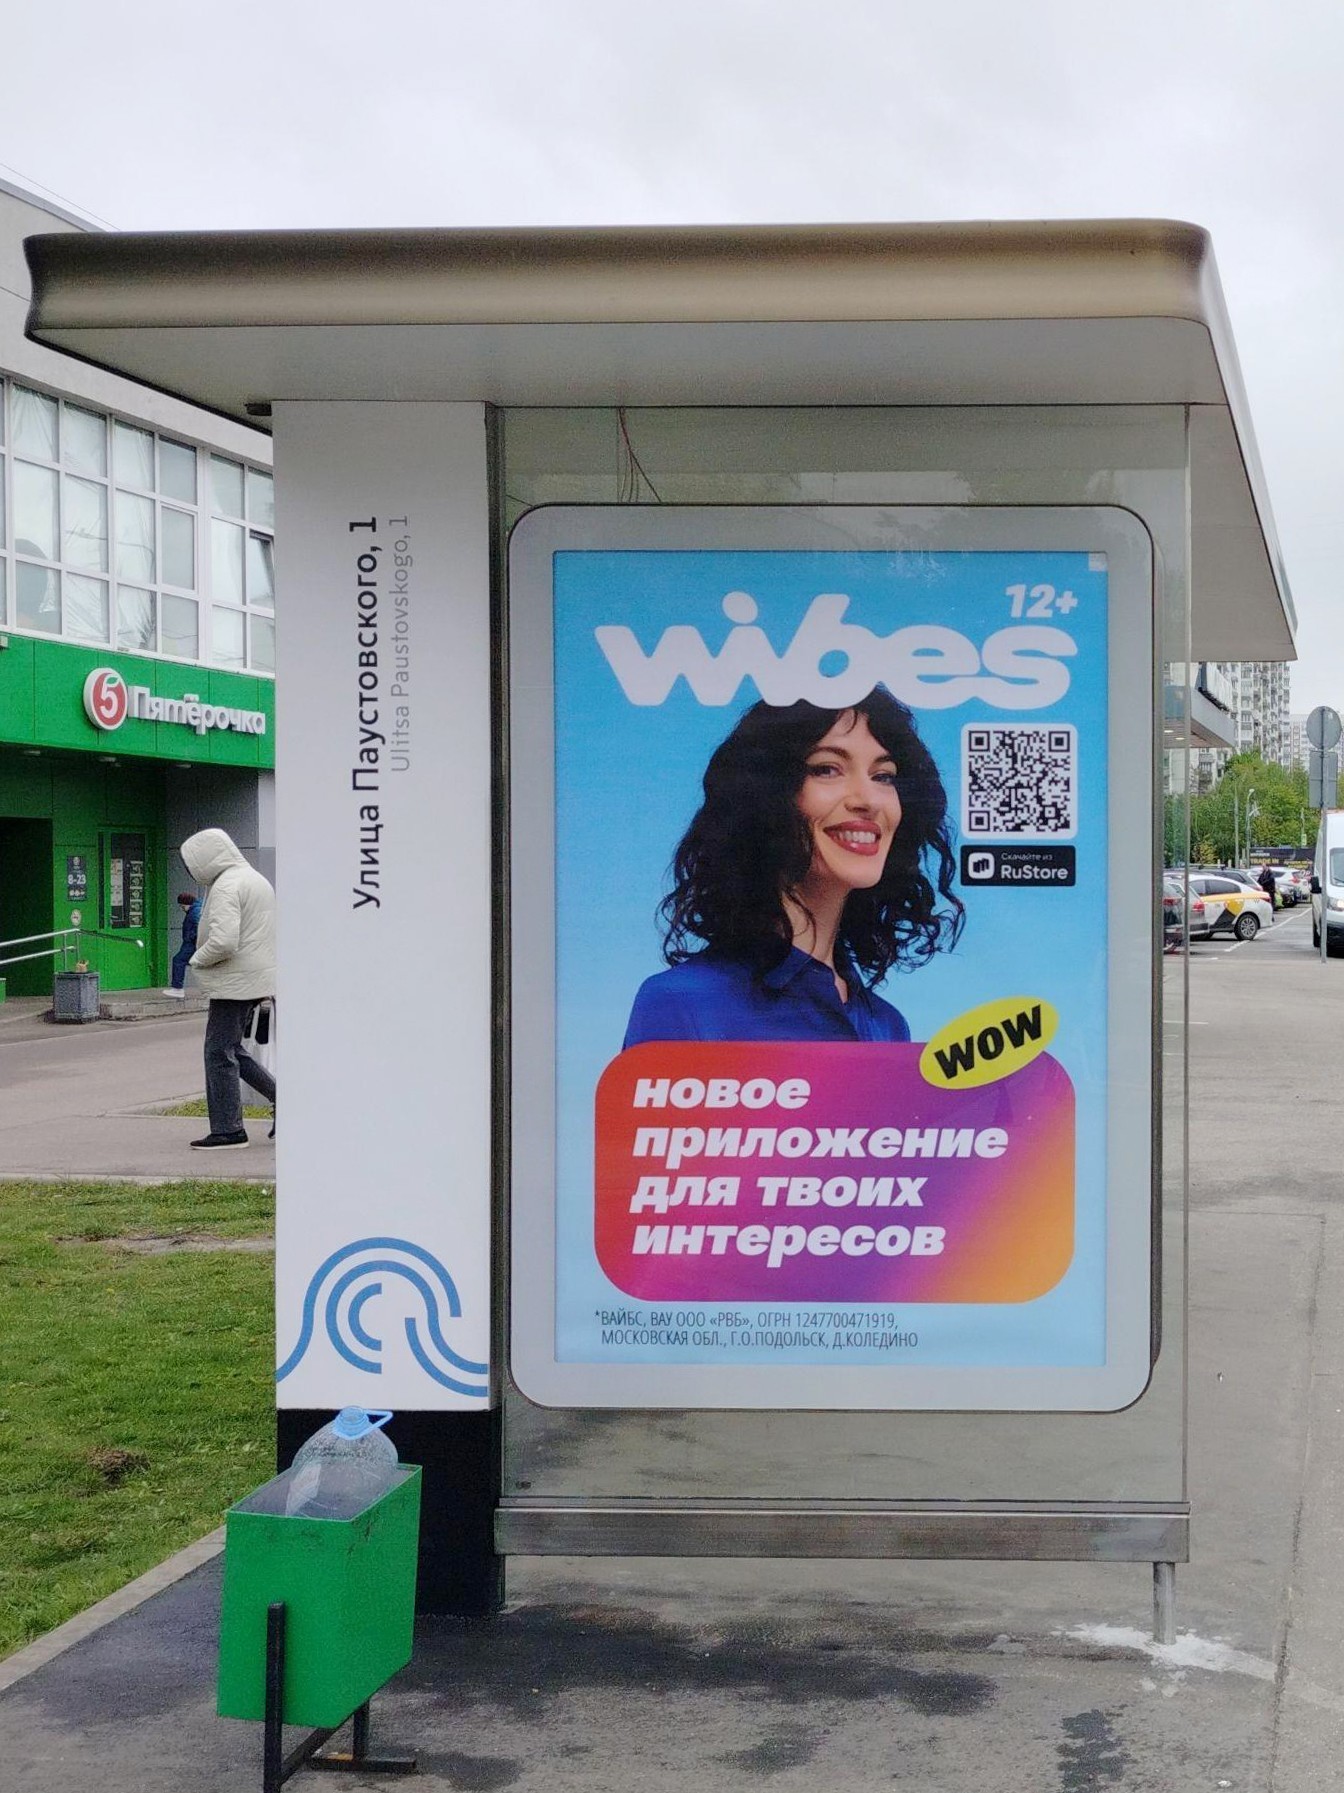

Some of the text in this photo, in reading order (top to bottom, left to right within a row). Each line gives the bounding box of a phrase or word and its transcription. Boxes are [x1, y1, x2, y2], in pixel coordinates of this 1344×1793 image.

[1005, 583, 1079, 618] 12+
[389, 515, 413, 772] Ulitsa Paustovskogo, 1
[594, 590, 1079, 711] wibes
[127, 685, 266, 735] Пятёрочка
[349, 516, 386, 910] Улица Паустовского, 1
[1001, 864, 1069, 880] RuStore
[933, 1004, 1043, 1080] WOW
[632, 1077, 812, 1109] новое
[632, 1126, 1009, 1170] приложение
[628, 1176, 928, 1214] для твоих
[631, 1224, 946, 1268] интересов
[602, 1329, 919, 1350] МОСКОВСКАЯ ОБЛ., Г.О.ПОДОЛЬСК, Д.КОЛЕДИНО
[651, 1311, 673, 1327] ВАУ
[676, 1311, 706, 1327] ООО
[709, 1311, 754, 1329] «РВБ»,
[757, 1312, 791, 1328] ОГРН
[796, 1312, 899, 1330] 1247700471919,
